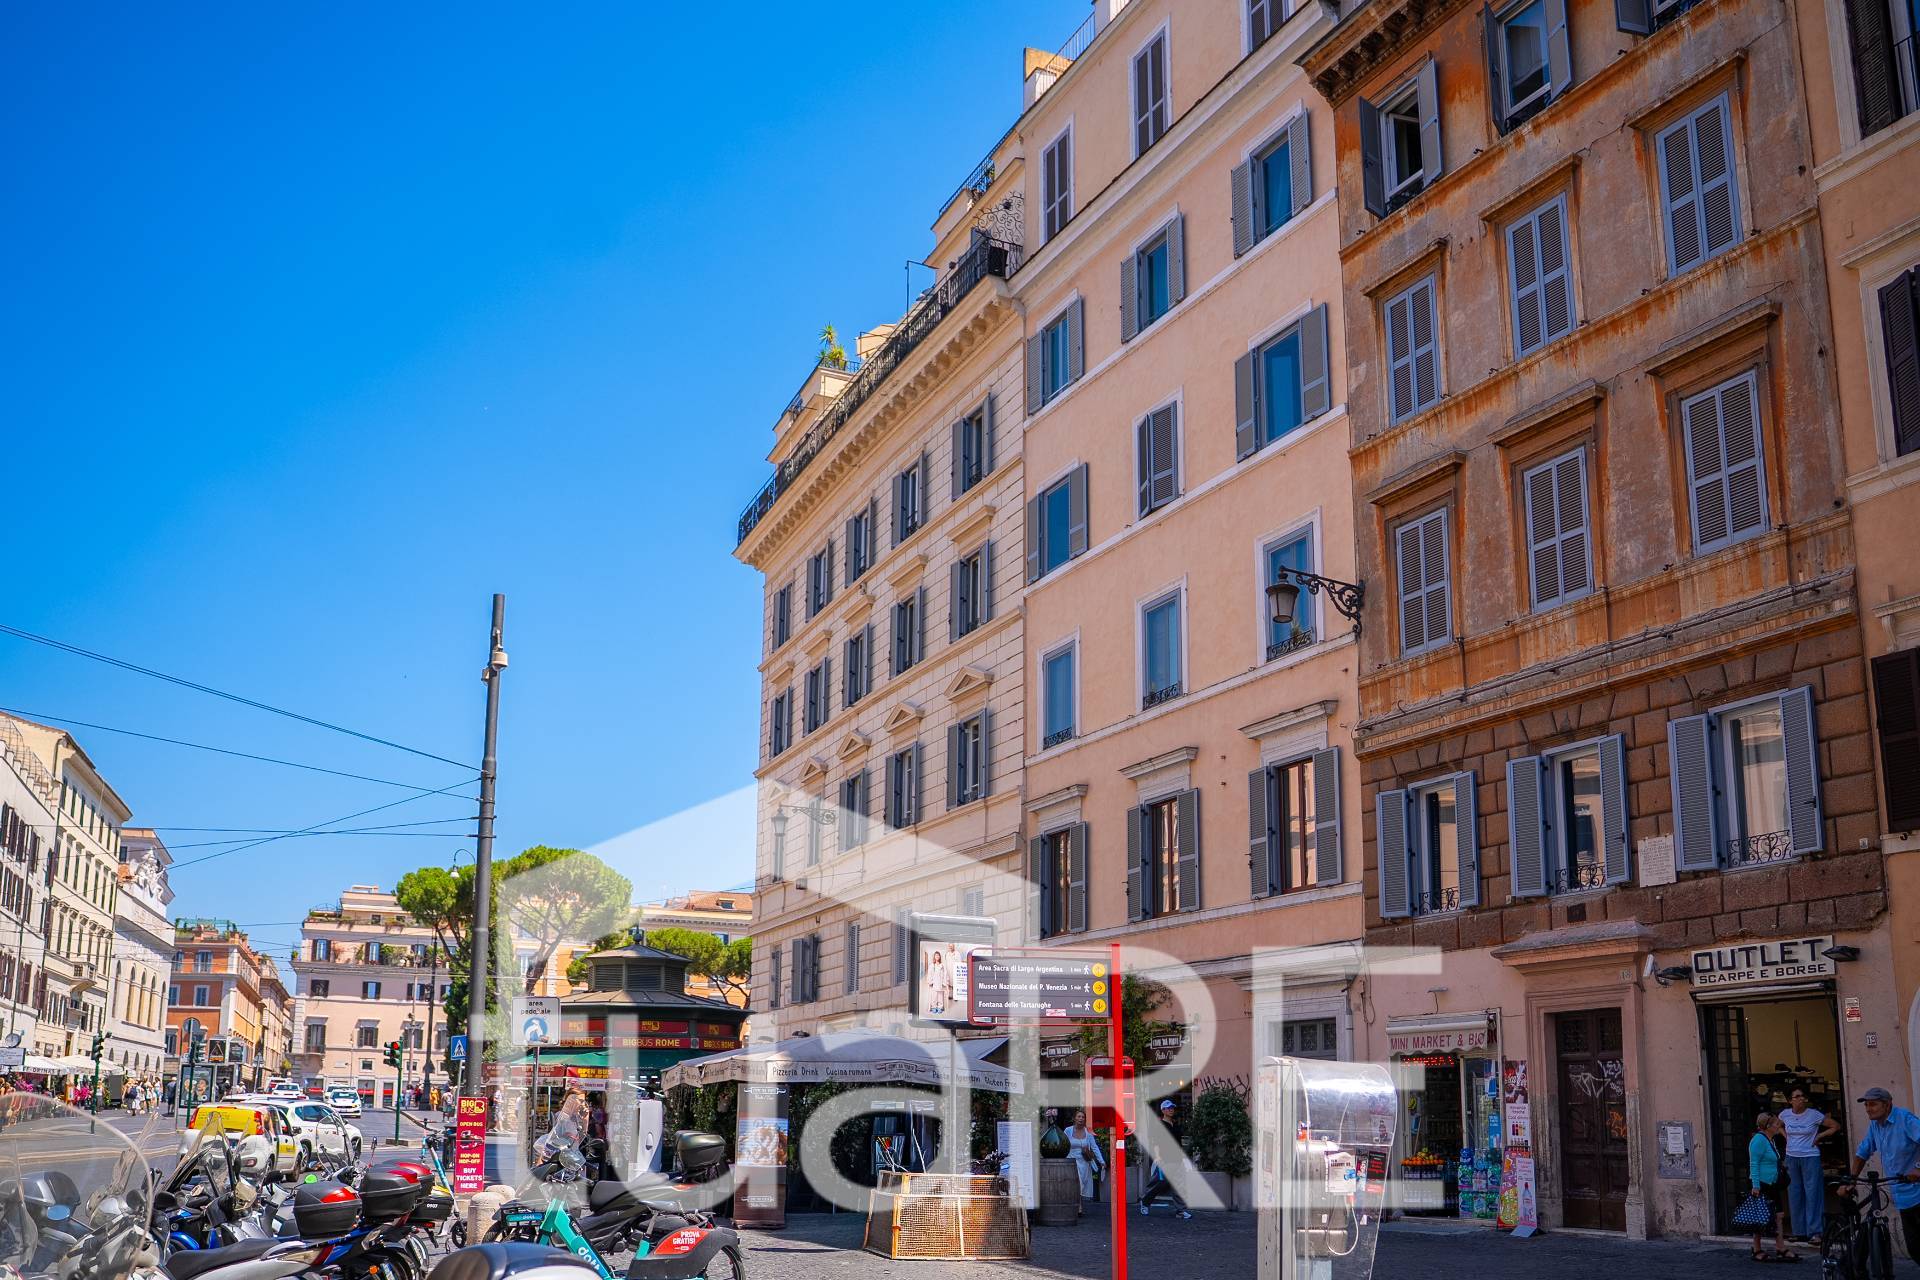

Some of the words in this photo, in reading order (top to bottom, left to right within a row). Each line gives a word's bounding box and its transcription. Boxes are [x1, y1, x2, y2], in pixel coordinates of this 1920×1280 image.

[1693, 938, 1825, 973] OUTLET
[1017, 965, 1034, 973] Largo
[1699, 970, 1755, 984] SCARPE
[1760, 969, 1769, 978] E
[1775, 963, 1827, 977] BORSE
[622, 1039, 653, 1047] BIGBUS
[655, 1039, 680, 1047] ROME
[1390, 1037, 1408, 1050] MINI
[1412, 1035, 1452, 1049] MARKET
[1457, 1033, 1464, 1047] &
[773, 1067, 798, 1076] Pizzeria
[801, 1066, 818, 1076] Drink
[826, 1067, 848, 1076] Cucina
[672, 1237, 696, 1245] GRATIS!
